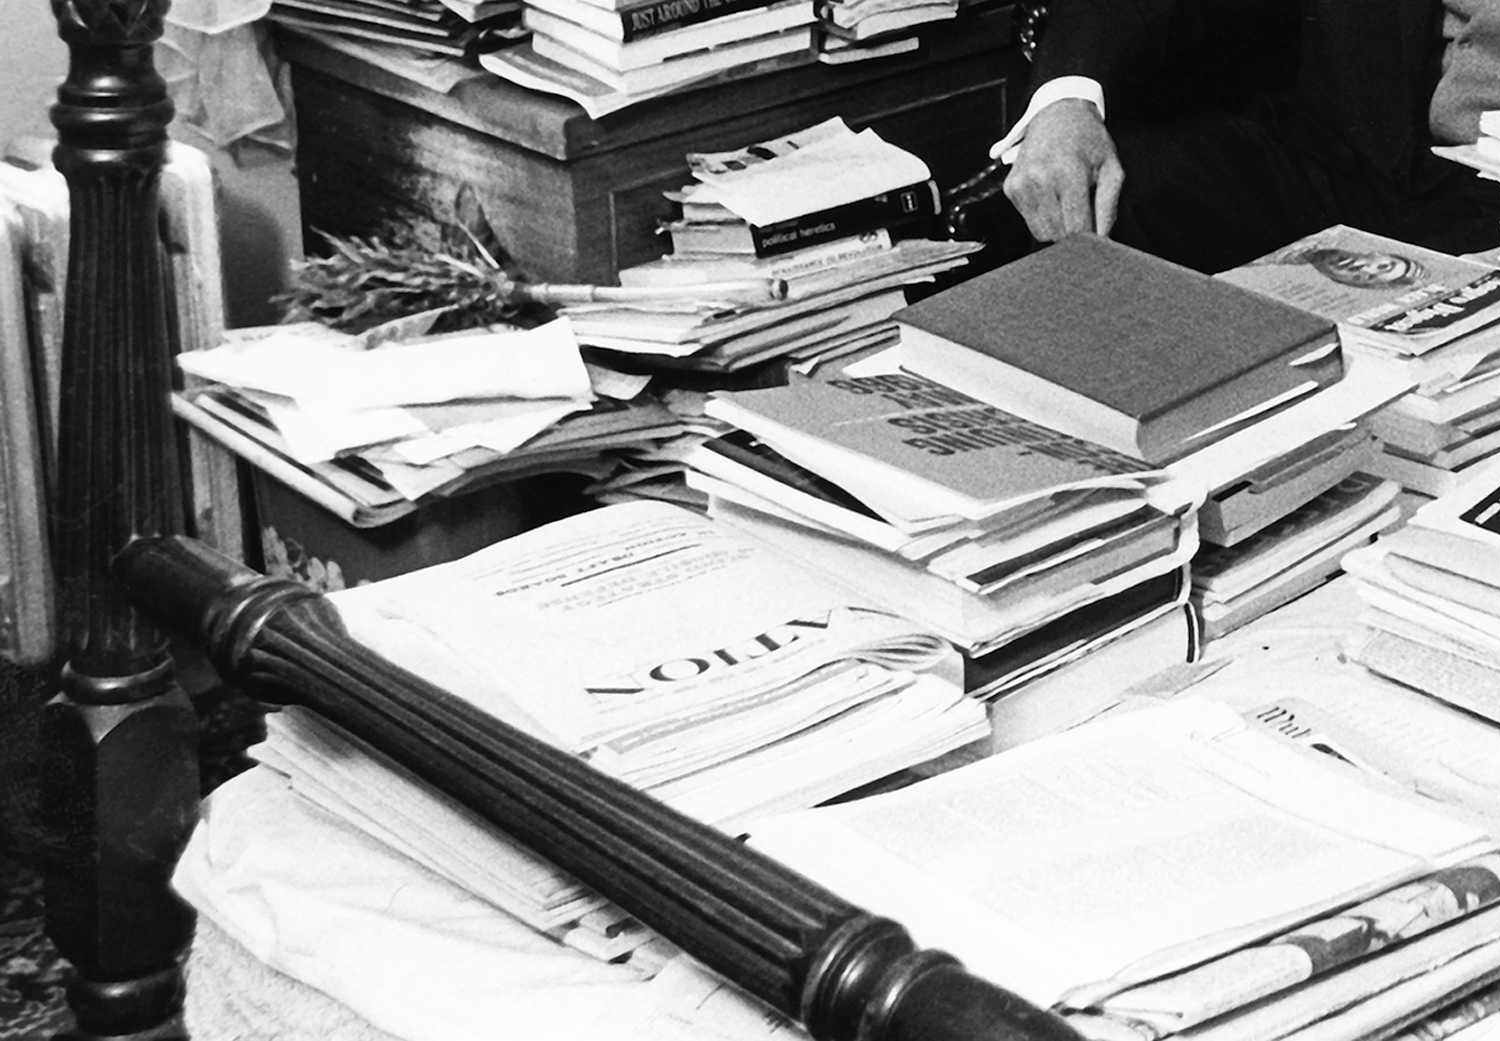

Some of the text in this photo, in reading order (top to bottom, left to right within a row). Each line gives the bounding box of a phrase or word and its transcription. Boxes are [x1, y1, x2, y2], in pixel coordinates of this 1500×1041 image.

[632, 8, 655, 31] JUST
[762, 221, 836, 249] political heretics
[885, 407, 1027, 435] CRISIS
[585, 606, 912, 696] NATION
